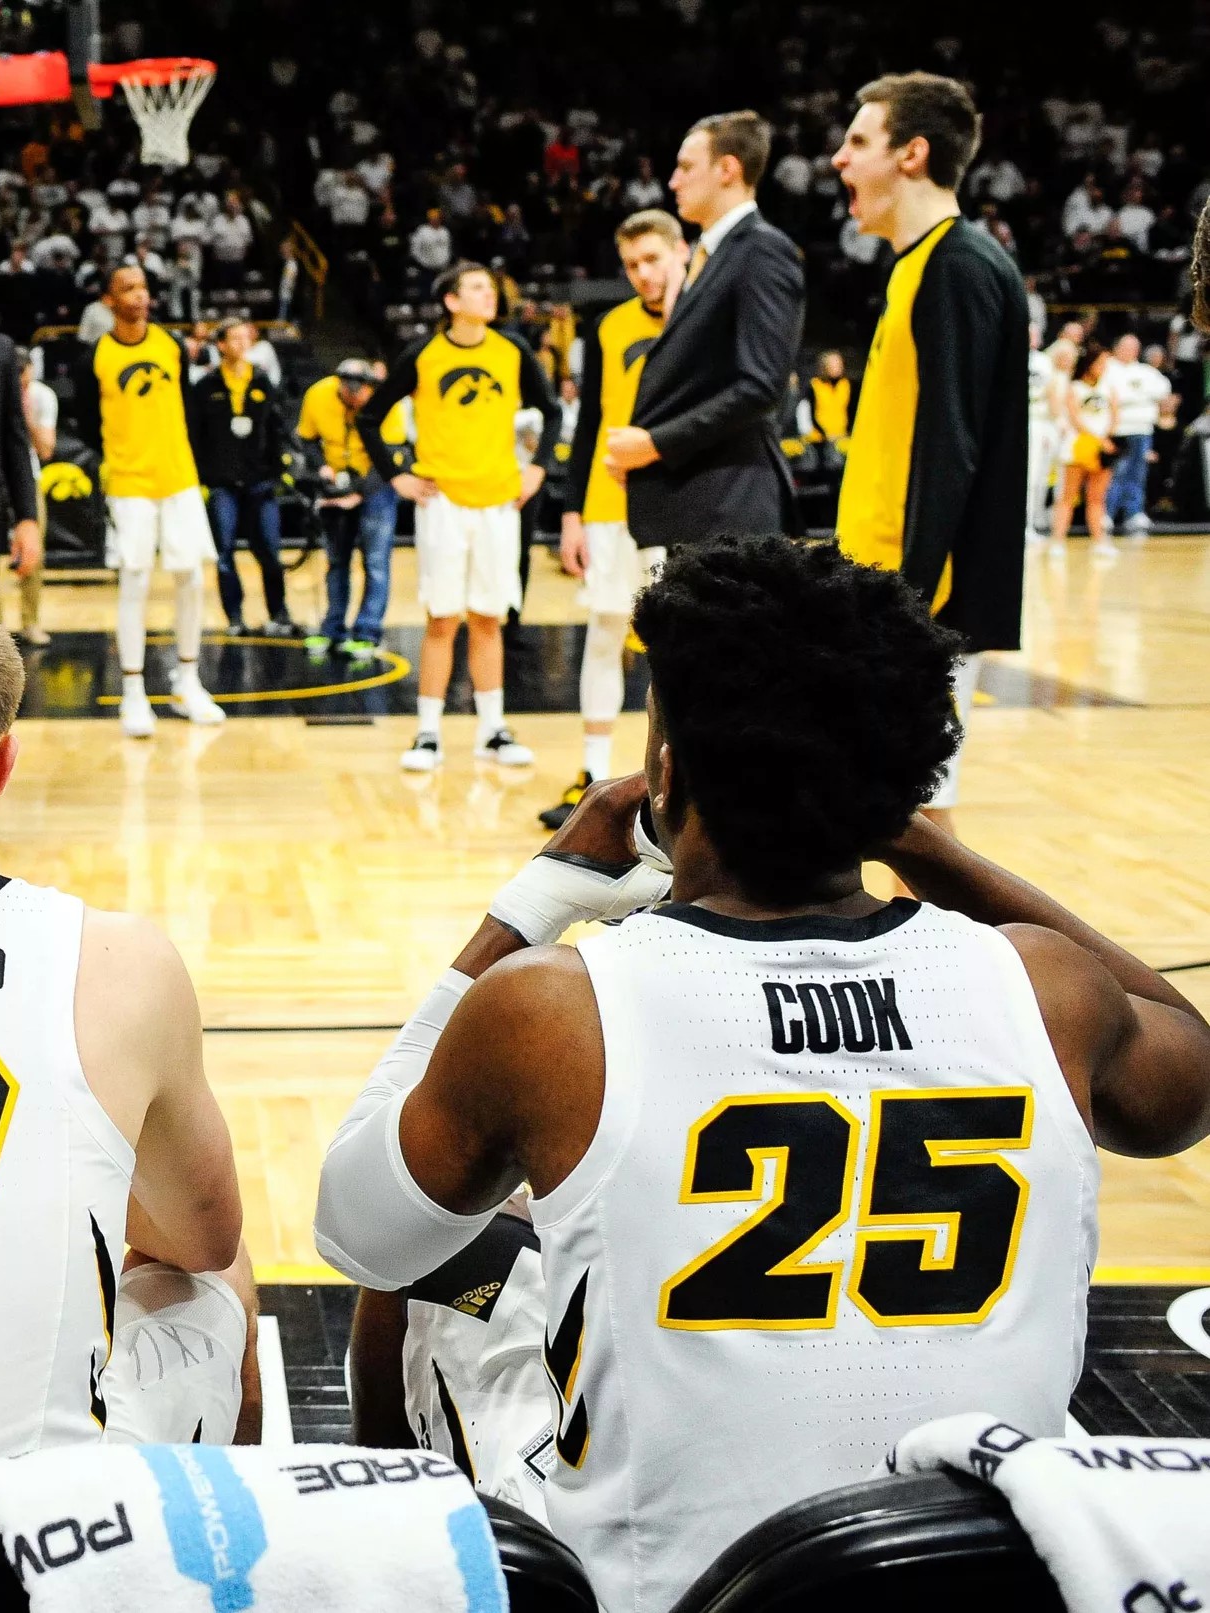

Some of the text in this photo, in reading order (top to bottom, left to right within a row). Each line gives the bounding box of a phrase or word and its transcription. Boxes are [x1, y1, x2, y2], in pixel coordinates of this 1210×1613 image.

[762, 977, 914, 1055] COOK
[657, 1086, 1035, 1331] 25
[450, 1281, 502, 1308] adida
